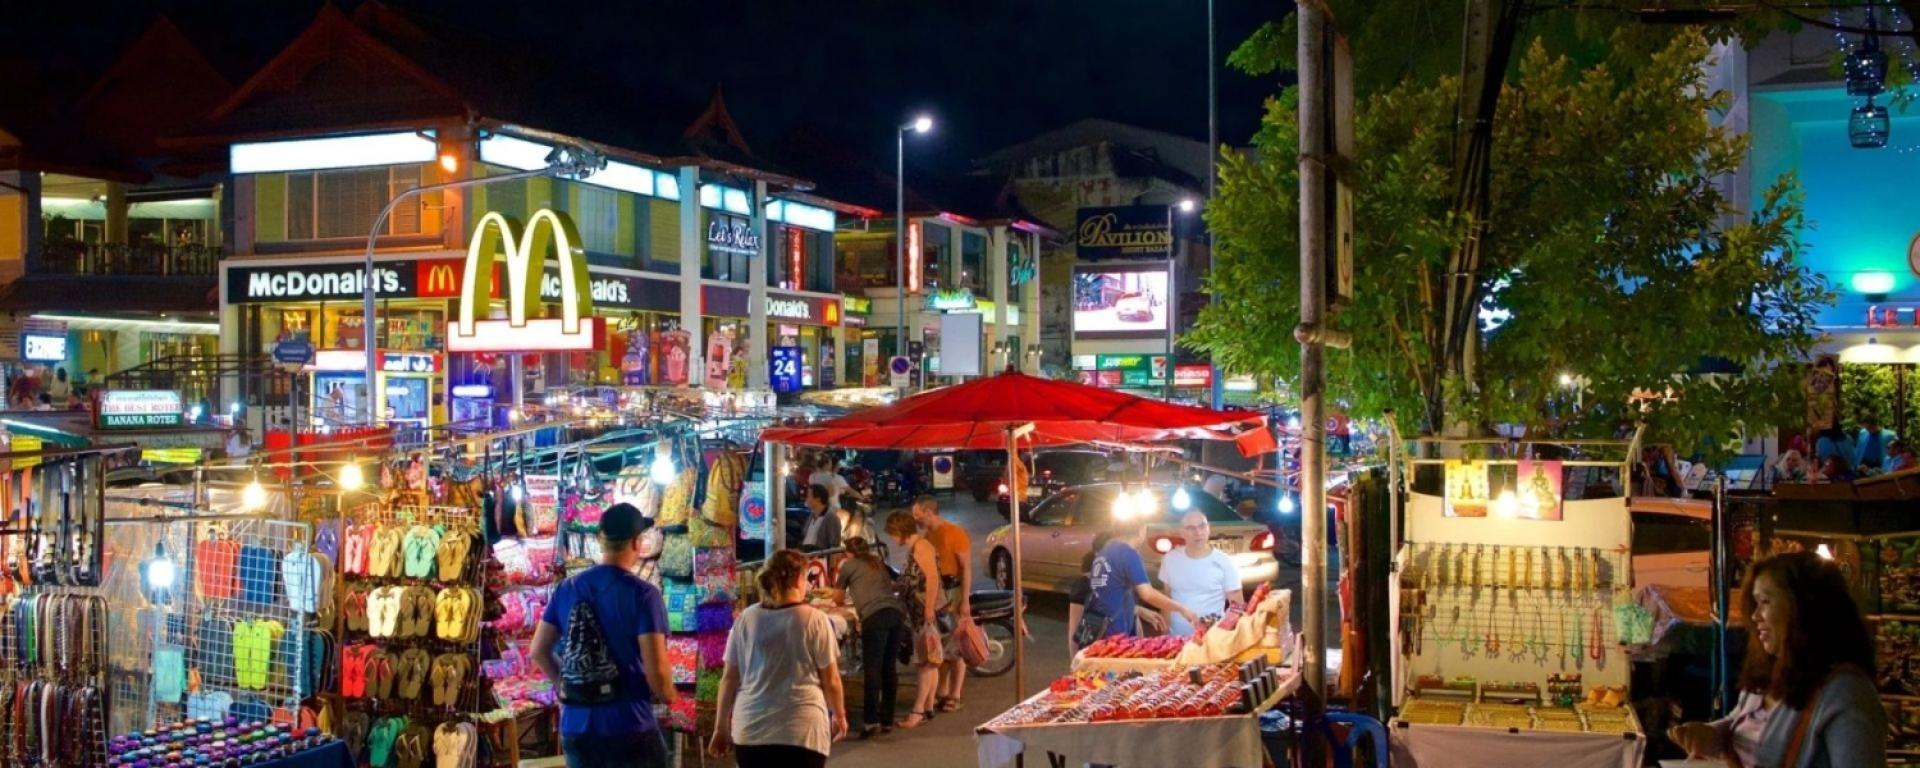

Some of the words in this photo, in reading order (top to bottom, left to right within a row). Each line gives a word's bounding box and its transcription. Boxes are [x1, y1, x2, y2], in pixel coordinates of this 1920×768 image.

[708, 222, 732, 243] Let's
[732, 224, 760, 249] Relax
[774, 359, 797, 376] 24
[108, 416, 145, 425] BANANA
[147, 416, 178, 424] ROTEE
